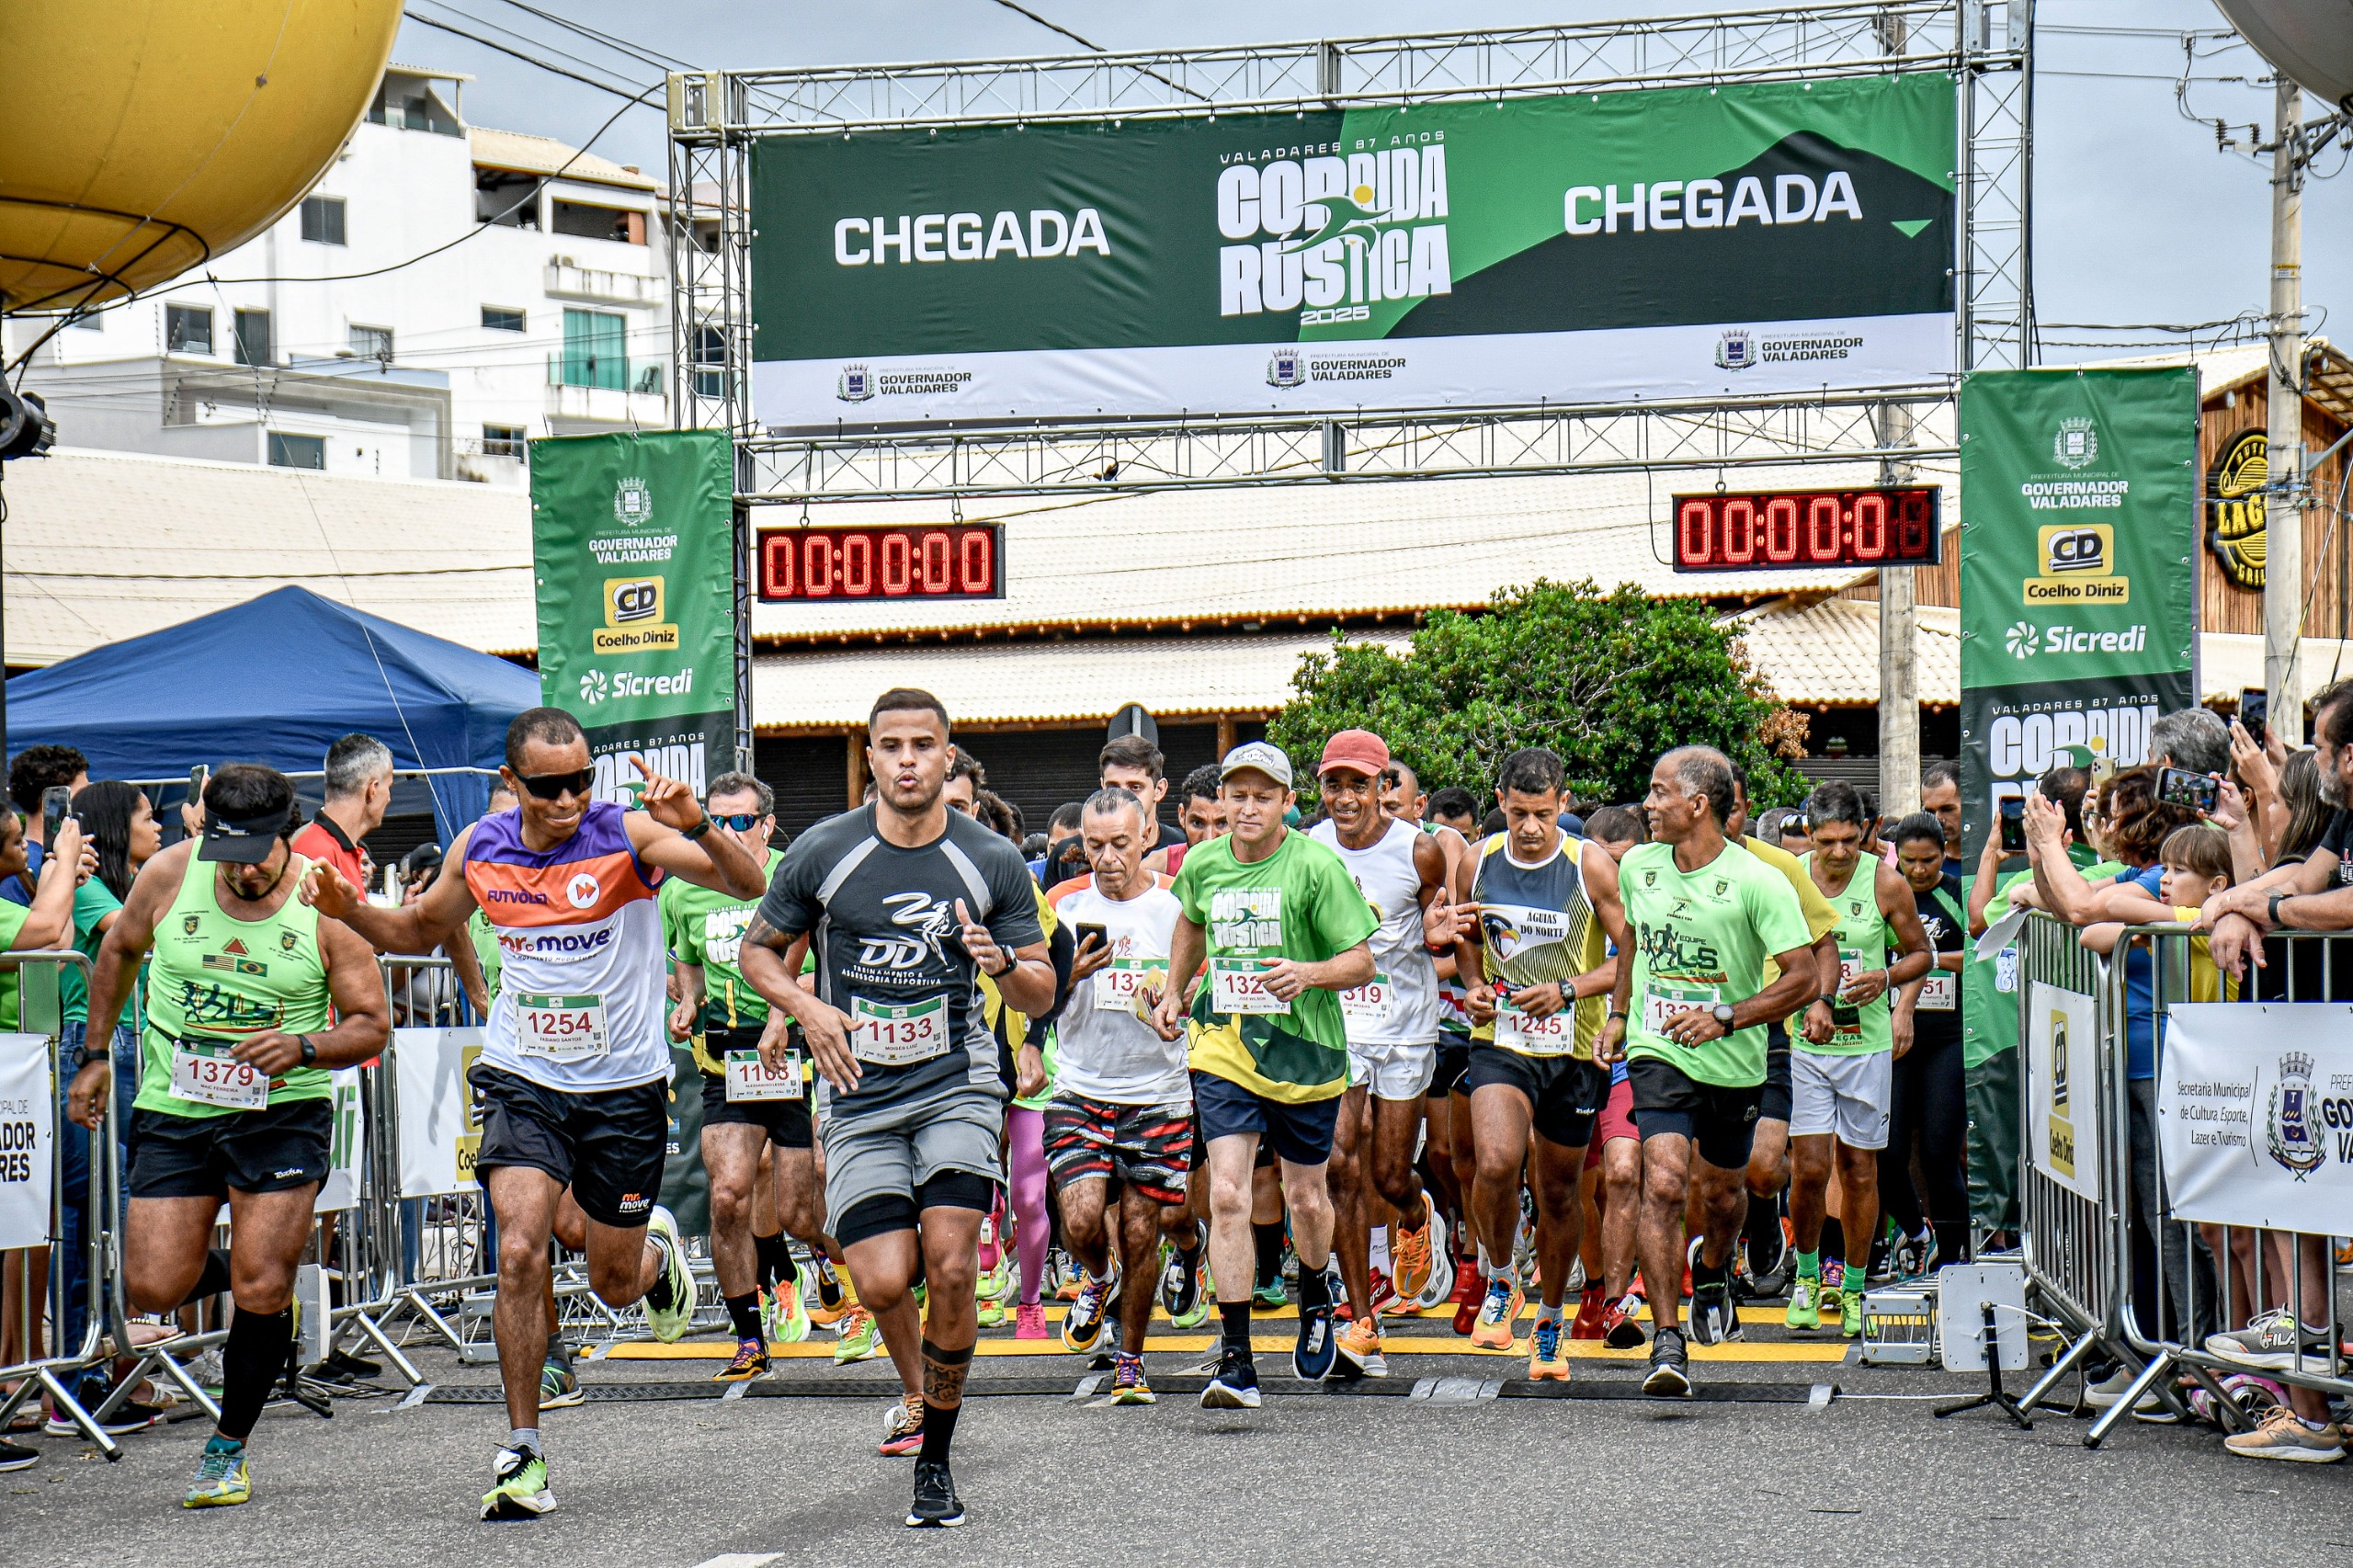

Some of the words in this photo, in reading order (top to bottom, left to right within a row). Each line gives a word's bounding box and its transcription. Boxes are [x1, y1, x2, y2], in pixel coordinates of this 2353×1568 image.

[1220, 142, 1341, 164] VALADARES
[1356, 138, 1376, 149] 87
[1391, 131, 1445, 145] ANOS
[1217, 143, 1449, 239] CORRIDA
[1563, 171, 1862, 234] CHEGADA
[835, 208, 1110, 266] CHEGADA
[1220, 223, 1451, 316] RÚSTICA
[1300, 305, 1370, 325] 2025
[1762, 337, 1863, 351] GOVERNADOR
[1311, 358, 1406, 370] GOVERNADOR
[1762, 349, 1848, 362] VALADARES
[880, 372, 972, 384] GOVERNADOR
[1312, 369, 1392, 381] VALADARES
[881, 383, 958, 395] VALADARES
[2021, 481, 2129, 495] GOVERNADOR
[2029, 494, 2121, 508] VALADARES
[2218, 494, 2268, 536] LAG
[588, 535, 678, 551] GOVERNADOR
[2048, 528, 2103, 561] CD
[596, 548, 672, 563] VALADARES
[767, 531, 990, 596] 00:00:00
[613, 580, 657, 611] CD
[2028, 584, 2081, 598] Coelho
[2086, 583, 2124, 597] Diniz
[597, 631, 641, 647] Coelho
[643, 631, 675, 644] Diniz
[2045, 625, 2146, 653] Sicredi
[612, 667, 693, 698] Sicredi
[1992, 699, 2083, 715] VALADARES
[2092, 698, 2109, 707] 87
[2119, 694, 2159, 705] ANOS
[593, 739, 641, 754] ADARES
[649, 737, 663, 746] 87
[668, 732, 705, 743] ANOS
[1527, 909, 1557, 925] ÁGUIAS
[1520, 924, 1534, 935] DO
[1535, 926, 1564, 938] NORTE
[1679, 935, 1707, 945] EQUIPE
[841, 968, 890, 984] ASSESSORIA
[892, 977, 941, 986] ESPORTIVA
[853, 964, 915, 978] TREINAMENTO
[1225, 974, 1264, 994] 132
[1344, 985, 1381, 1004] 319
[528, 1011, 593, 1035] 1254
[869, 1017, 932, 1043] 1133
[1508, 1015, 1562, 1035] 1245
[188, 1059, 254, 1086] 1379
[2177, 1081, 2212, 1097] Secretaria
[2214, 1082, 2251, 1102] Municipal
[18, 1100, 28, 1114] DE
[2180, 1106, 2189, 1119] de
[2189, 1105, 2219, 1122] Cultura,
[2220, 1106, 2248, 1125] Esporte,
[2191, 1130, 2210, 1145] Lazer
[2211, 1136, 2217, 1144] e
[2217, 1131, 2246, 1148] Turismo
